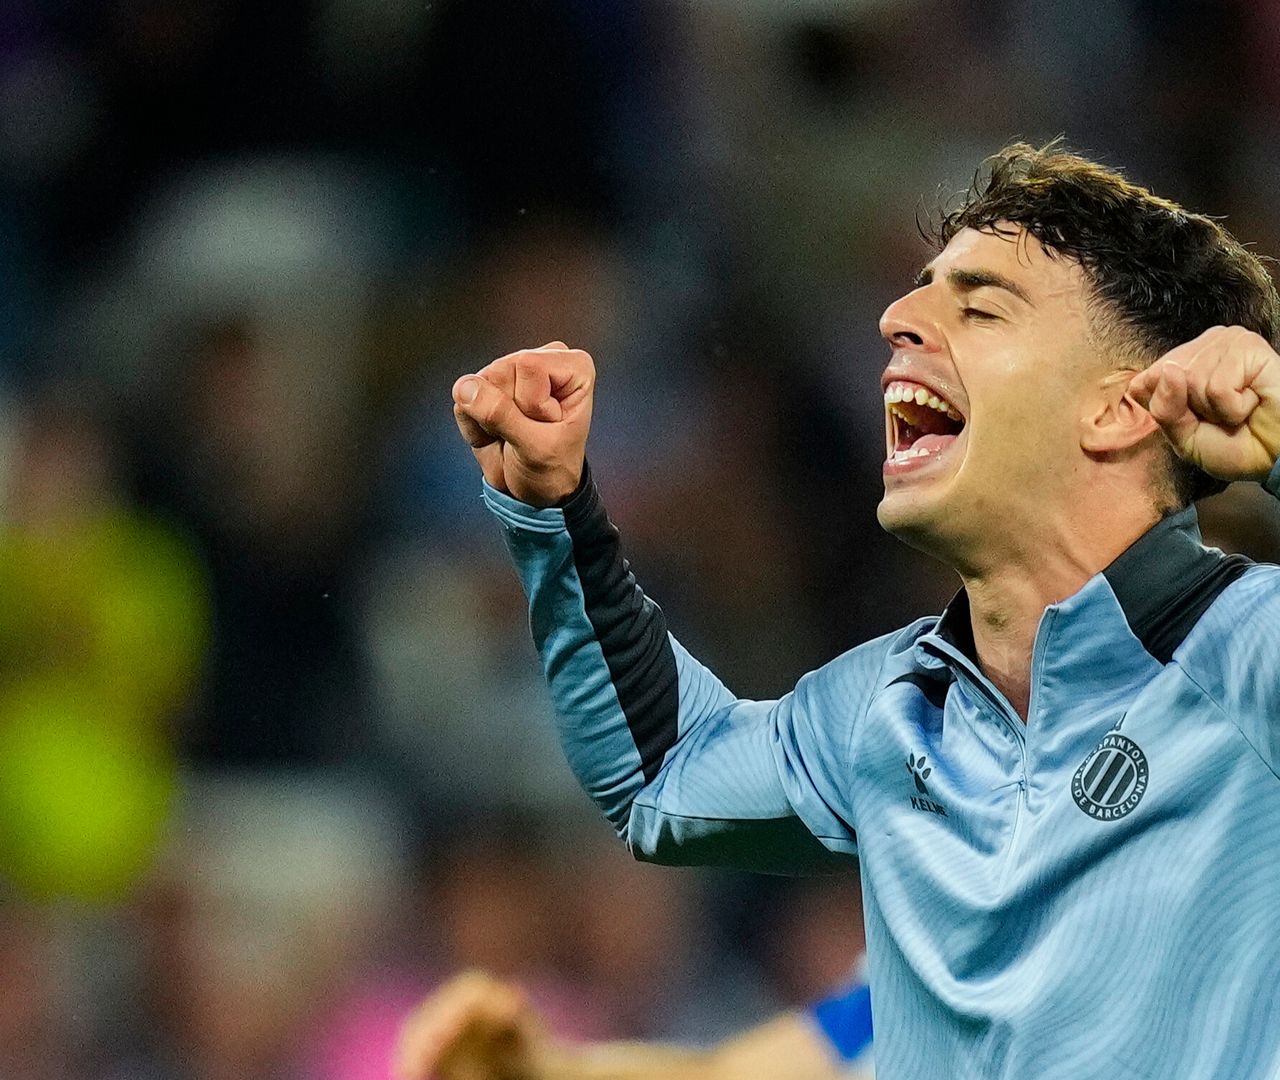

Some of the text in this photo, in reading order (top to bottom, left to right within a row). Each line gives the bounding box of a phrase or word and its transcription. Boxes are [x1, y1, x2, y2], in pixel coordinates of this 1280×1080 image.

[1096, 736, 1144, 767] PANYOL
[1074, 775, 1147, 819] DE BARCELONA
